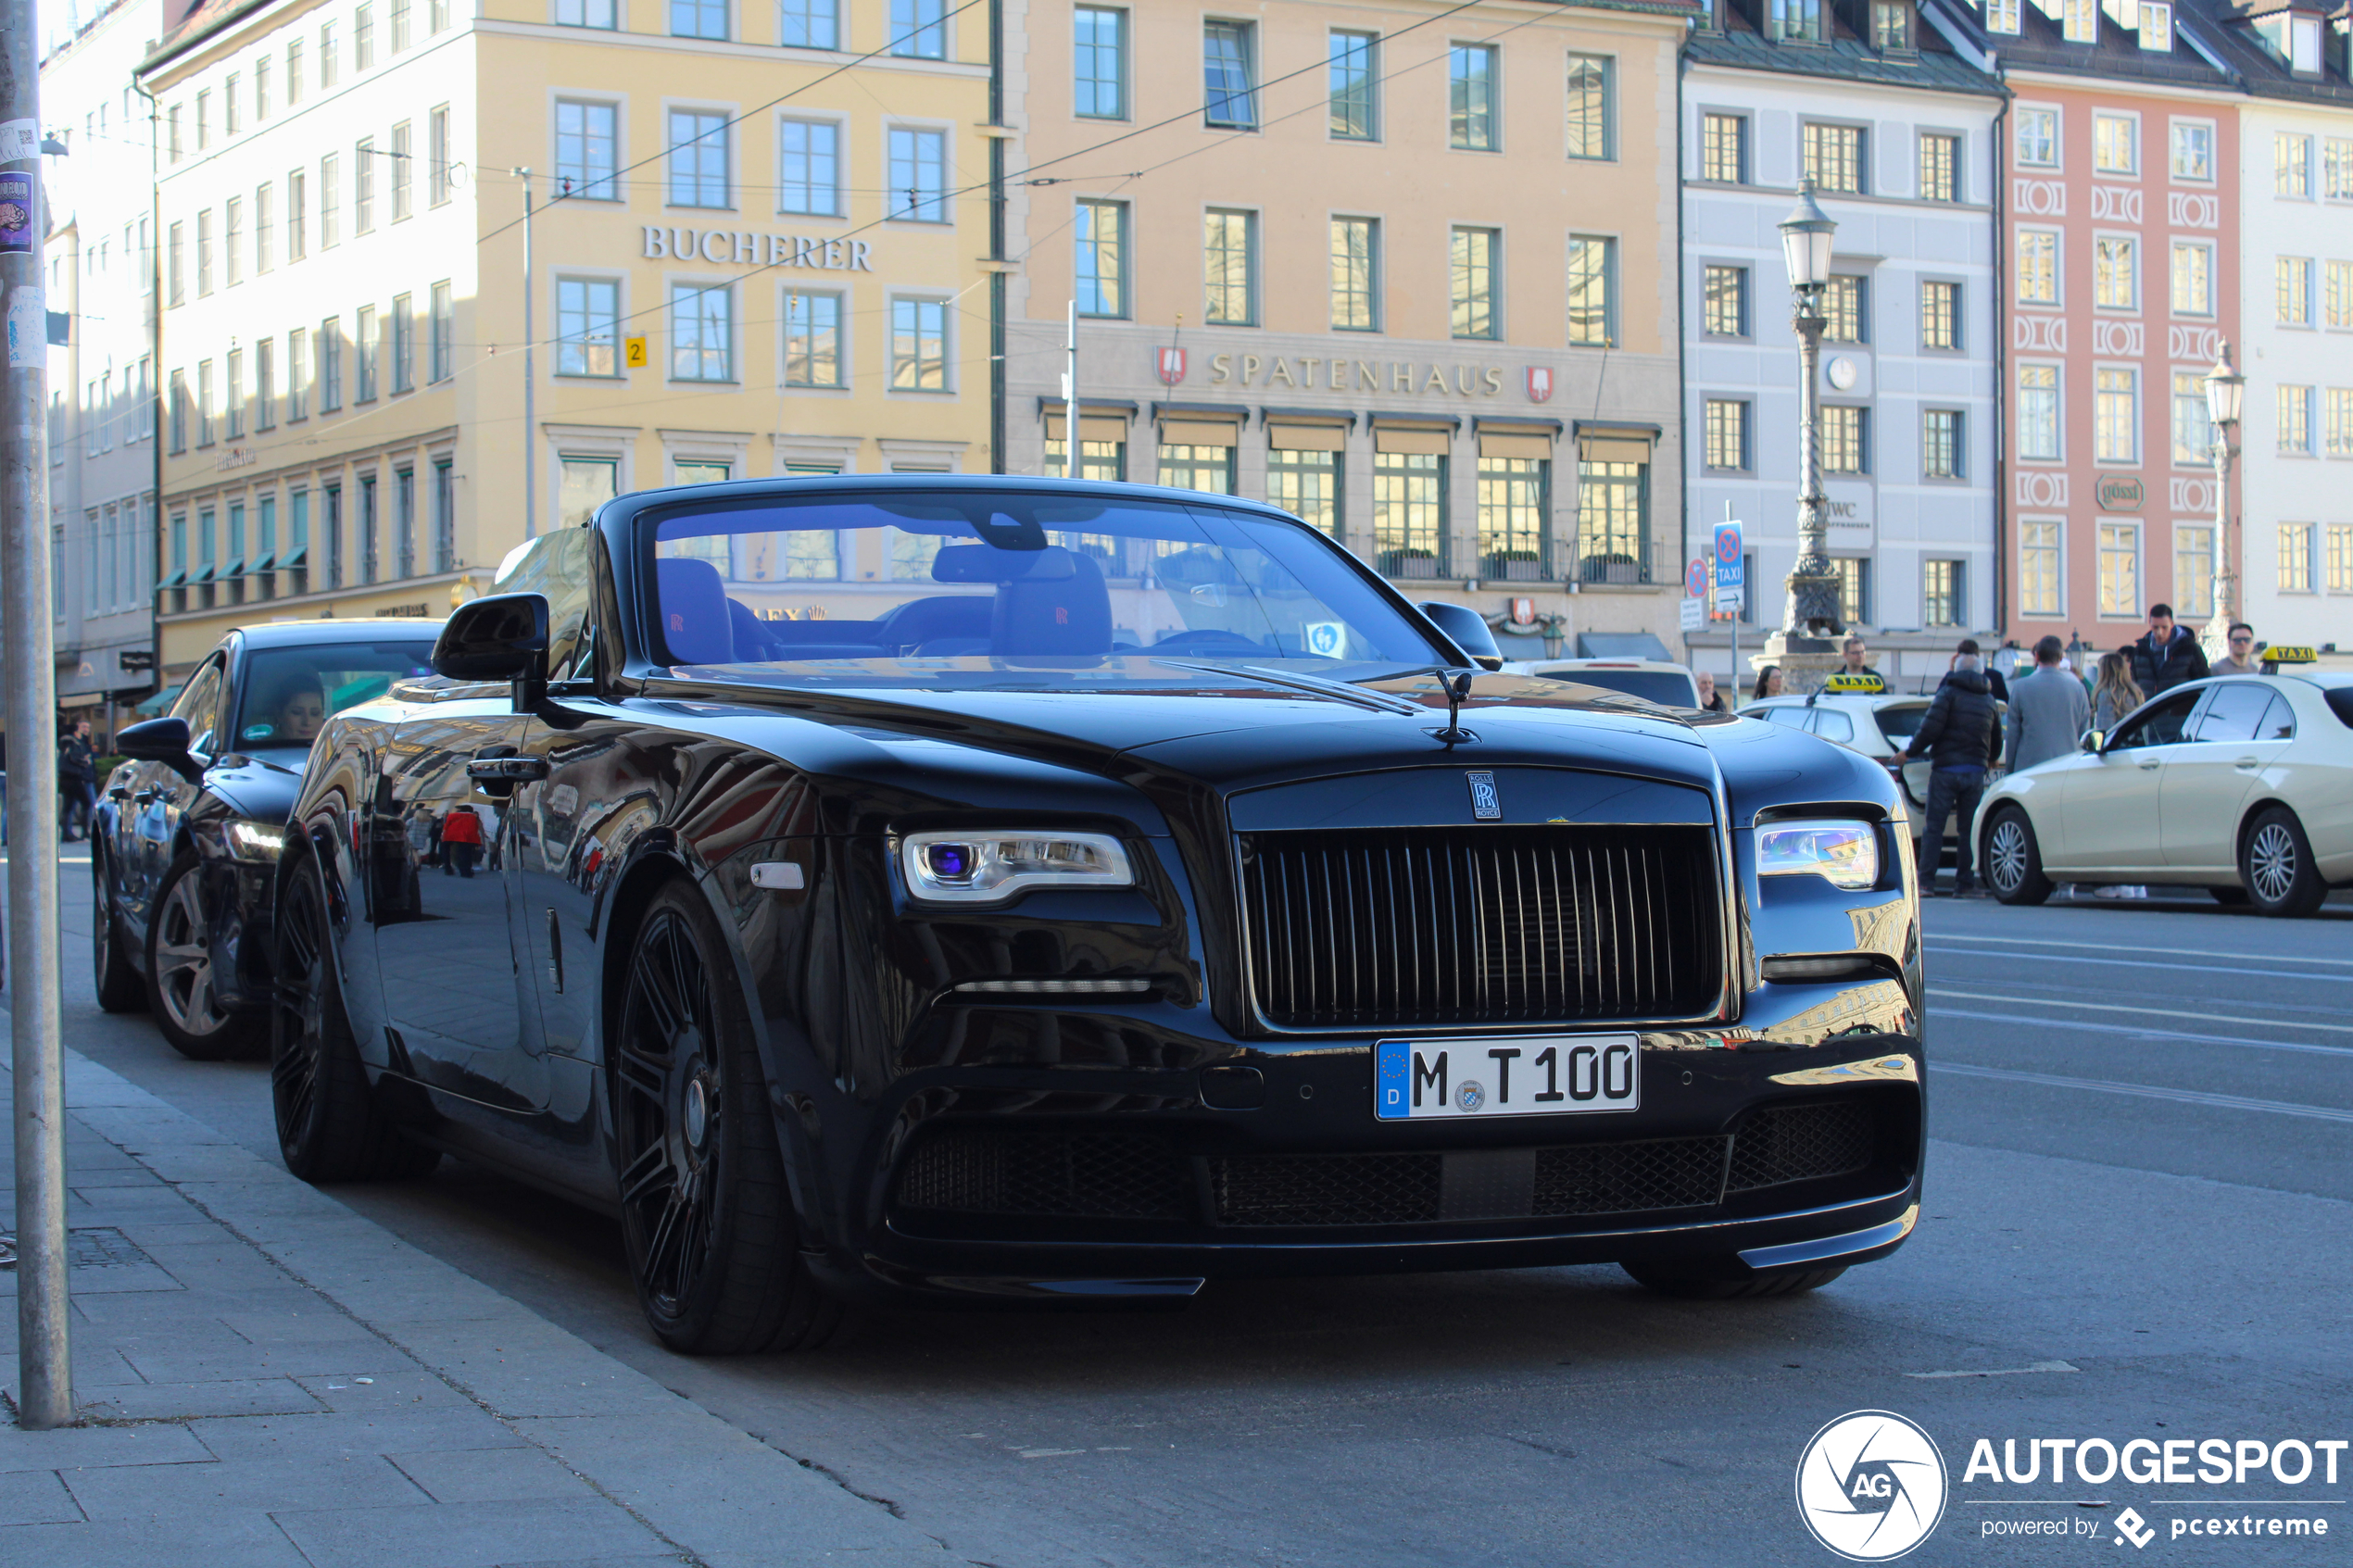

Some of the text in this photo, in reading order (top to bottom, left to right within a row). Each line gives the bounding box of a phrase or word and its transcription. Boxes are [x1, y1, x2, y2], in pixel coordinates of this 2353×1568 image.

[641, 225, 875, 272] BUCHERER
[630, 343, 641, 361] 2
[1210, 353, 1504, 396] SPATENHAUS
[1826, 501, 1856, 519] IWC
[1718, 566, 1742, 583] TAXI
[751, 608, 801, 621] LEX
[2278, 647, 2313, 659] TAXI
[1413, 1050, 1449, 1108] M
[1387, 1089, 1400, 1105] D
